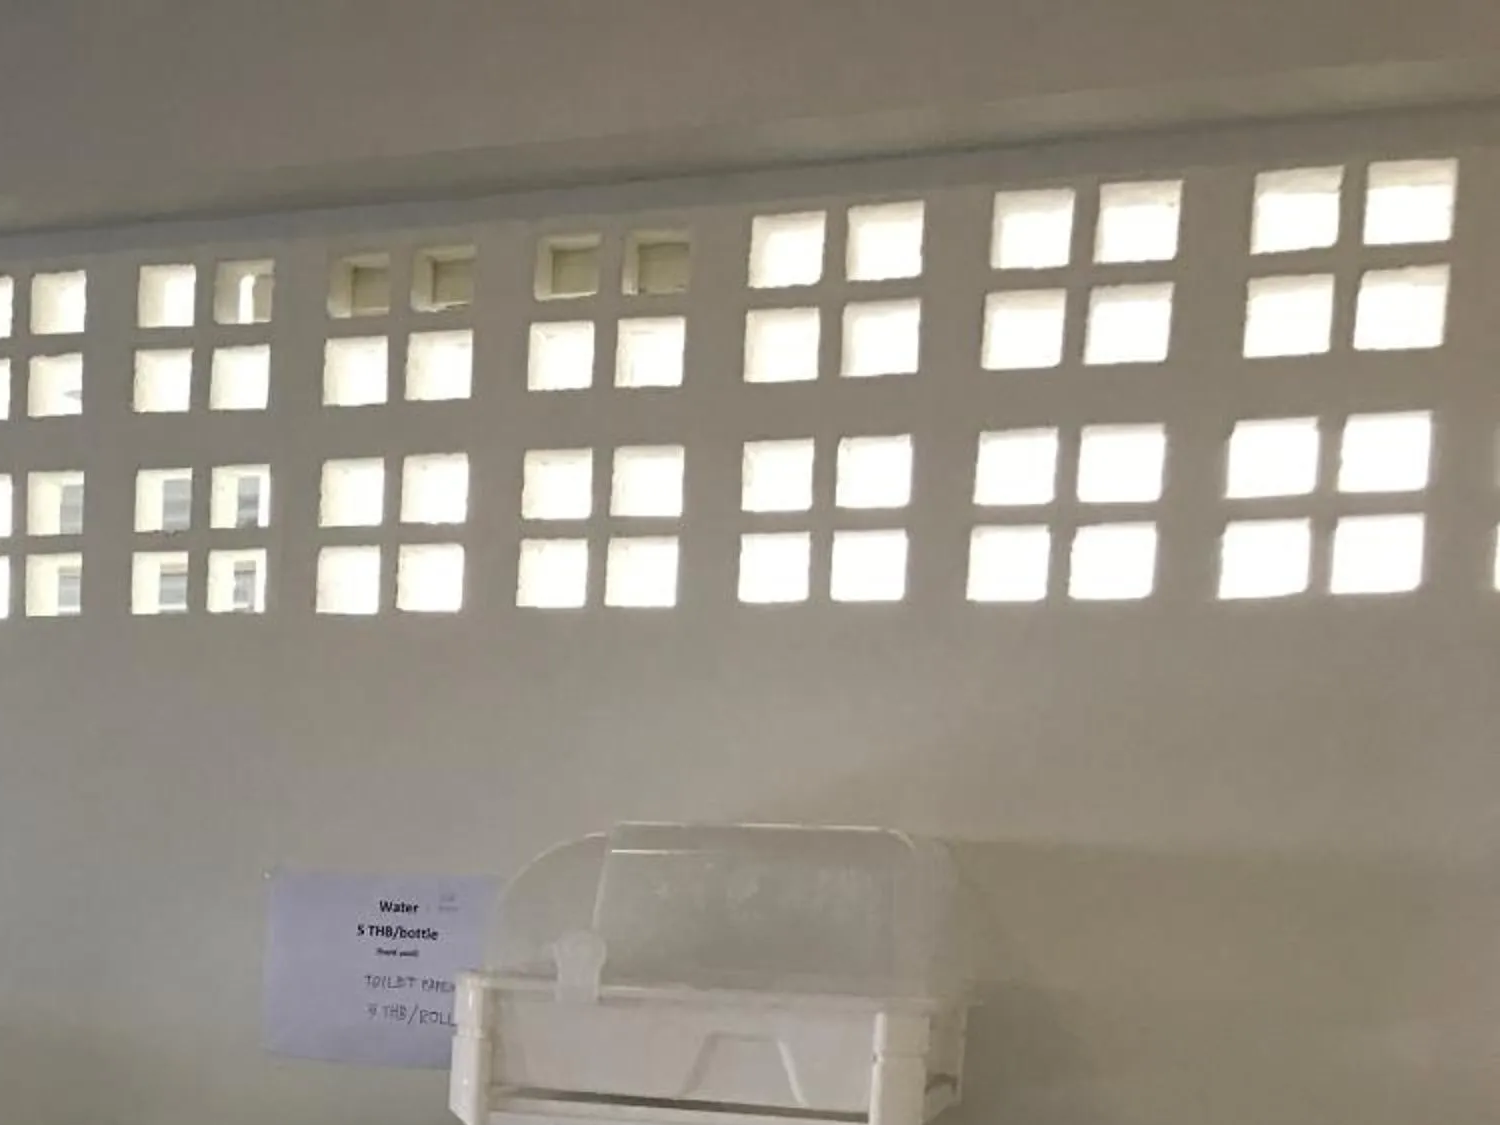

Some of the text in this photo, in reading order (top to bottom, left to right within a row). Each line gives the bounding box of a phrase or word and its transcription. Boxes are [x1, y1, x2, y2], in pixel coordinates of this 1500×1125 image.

[379, 900, 420, 913] Water
[357, 924, 439, 941] 5 THB/bottle
[364, 975, 417, 989] TOILET
